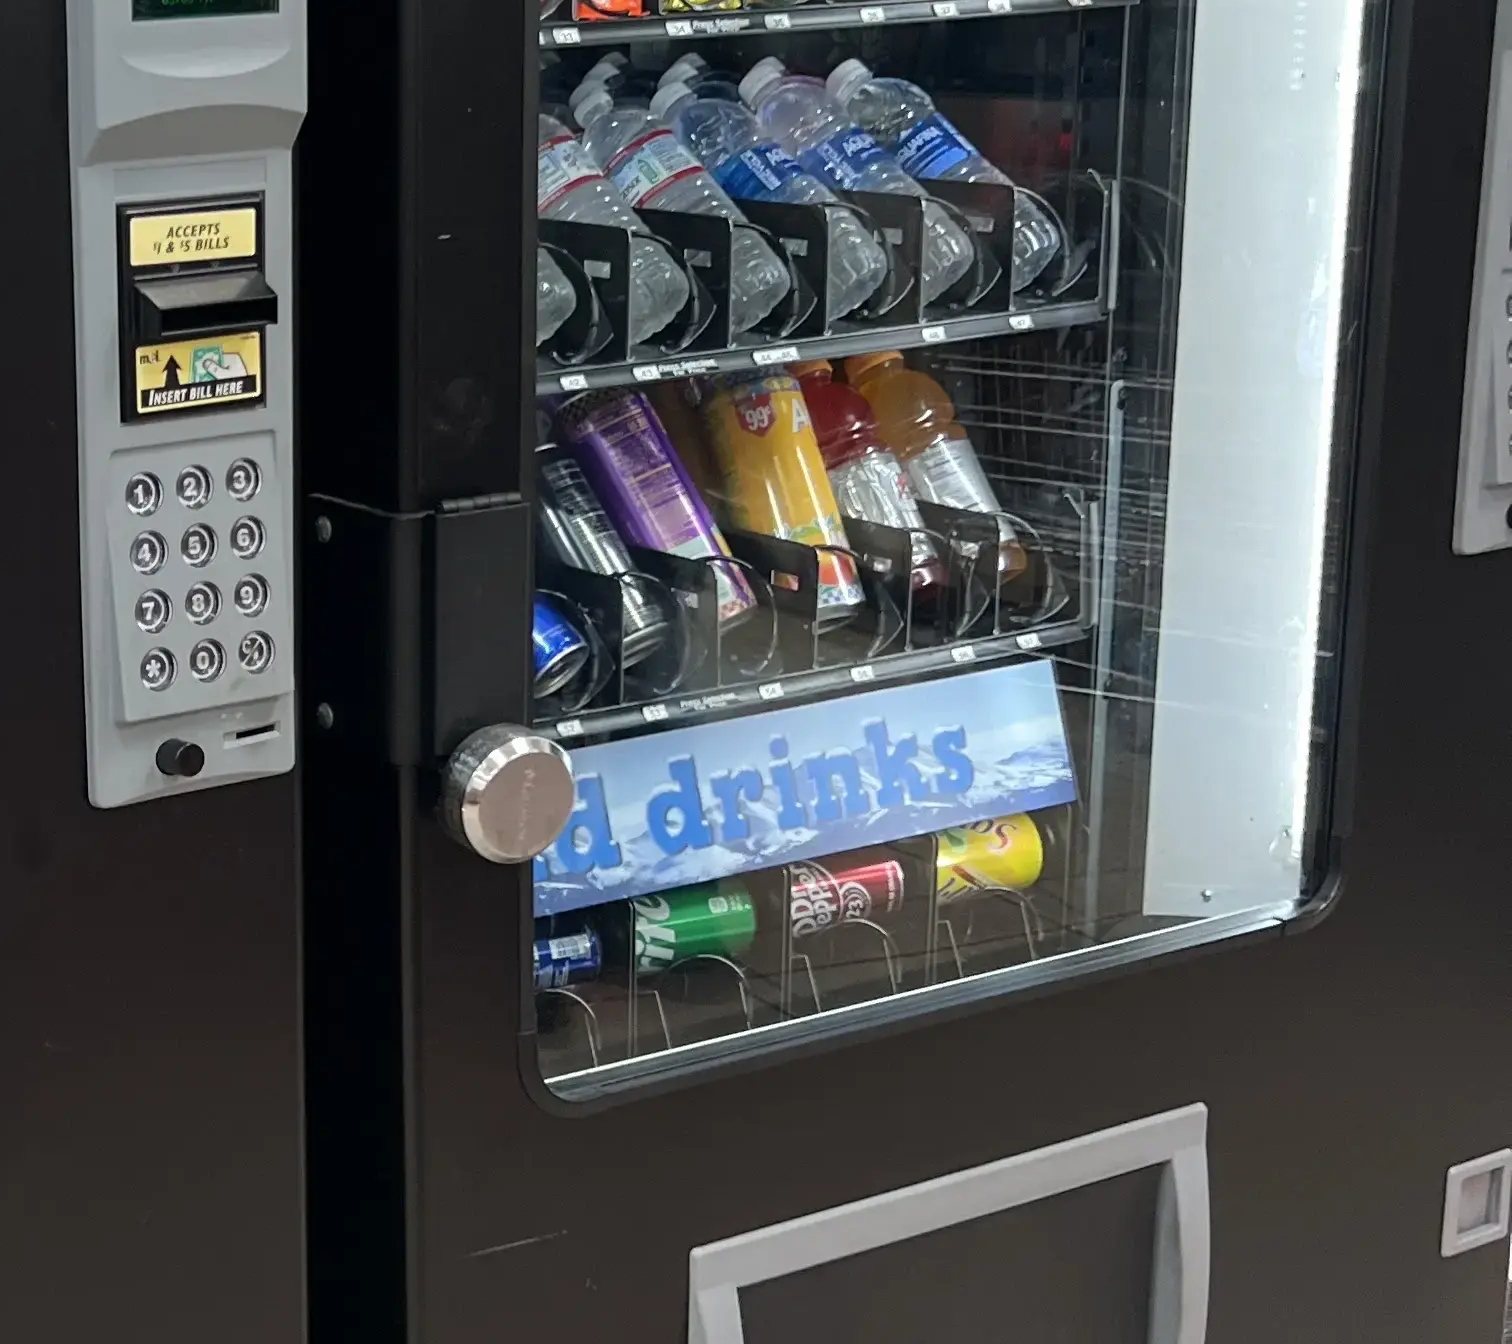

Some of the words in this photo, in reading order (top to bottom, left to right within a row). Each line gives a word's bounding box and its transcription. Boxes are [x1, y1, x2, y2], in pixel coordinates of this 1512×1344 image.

[153, 241, 161, 254] $1
[166, 241, 174, 253] &
[180, 239, 190, 252] $5
[195, 237, 229, 250] BILLS
[167, 223, 220, 239] ACCEPTS
[149, 389, 186, 406] INSERT
[190, 386, 211, 399] BILL
[215, 381, 243, 395] HERE
[136, 485, 144, 504] 1
[184, 477, 196, 497] 2
[233, 471, 245, 490] 3
[138, 543, 150, 563] 4
[188, 536, 200, 555] 5
[238, 528, 249, 546] 6
[143, 602, 154, 621] 7
[193, 594, 204, 613] 8
[241, 586, 252, 605] 9
[197, 652, 209, 671] 0
[646, 718, 975, 851] drinks
